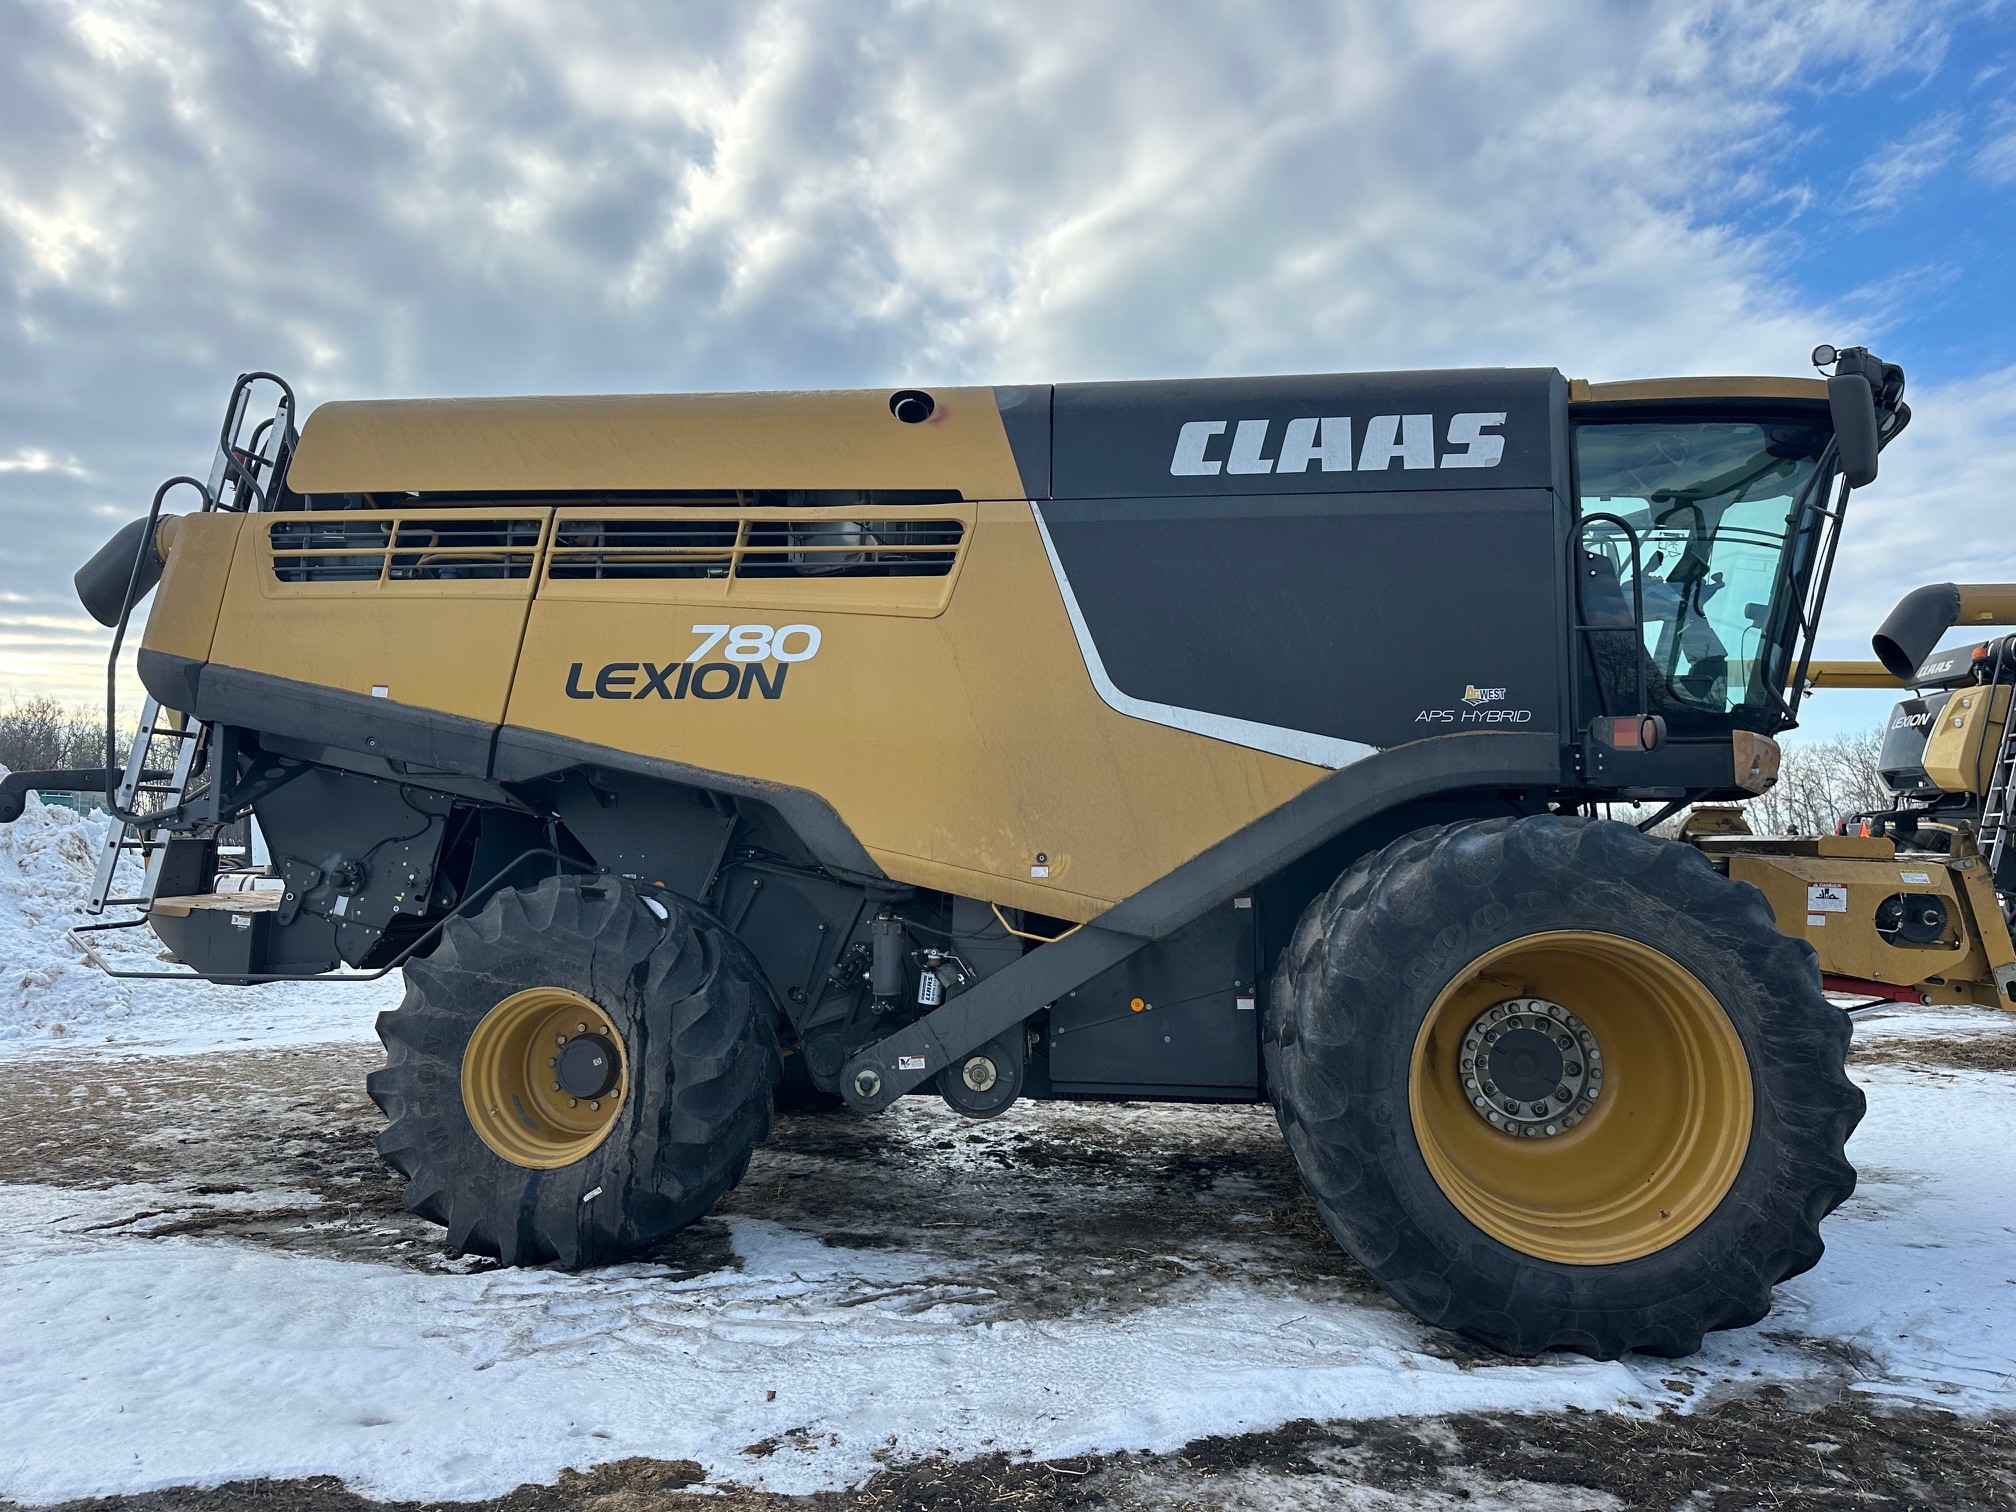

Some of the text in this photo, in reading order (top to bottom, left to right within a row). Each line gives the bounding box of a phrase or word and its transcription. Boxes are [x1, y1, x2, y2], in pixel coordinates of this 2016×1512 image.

[1170, 412, 1507, 475] CLAAS
[685, 624, 822, 662] 780
[565, 662, 789, 699] LEXION
[1916, 660, 1954, 679] CLAAS
[1415, 710, 1532, 722] APS HYBRID
[1892, 713, 1932, 730] LEXION
[925, 976, 933, 1001] CLAAS
